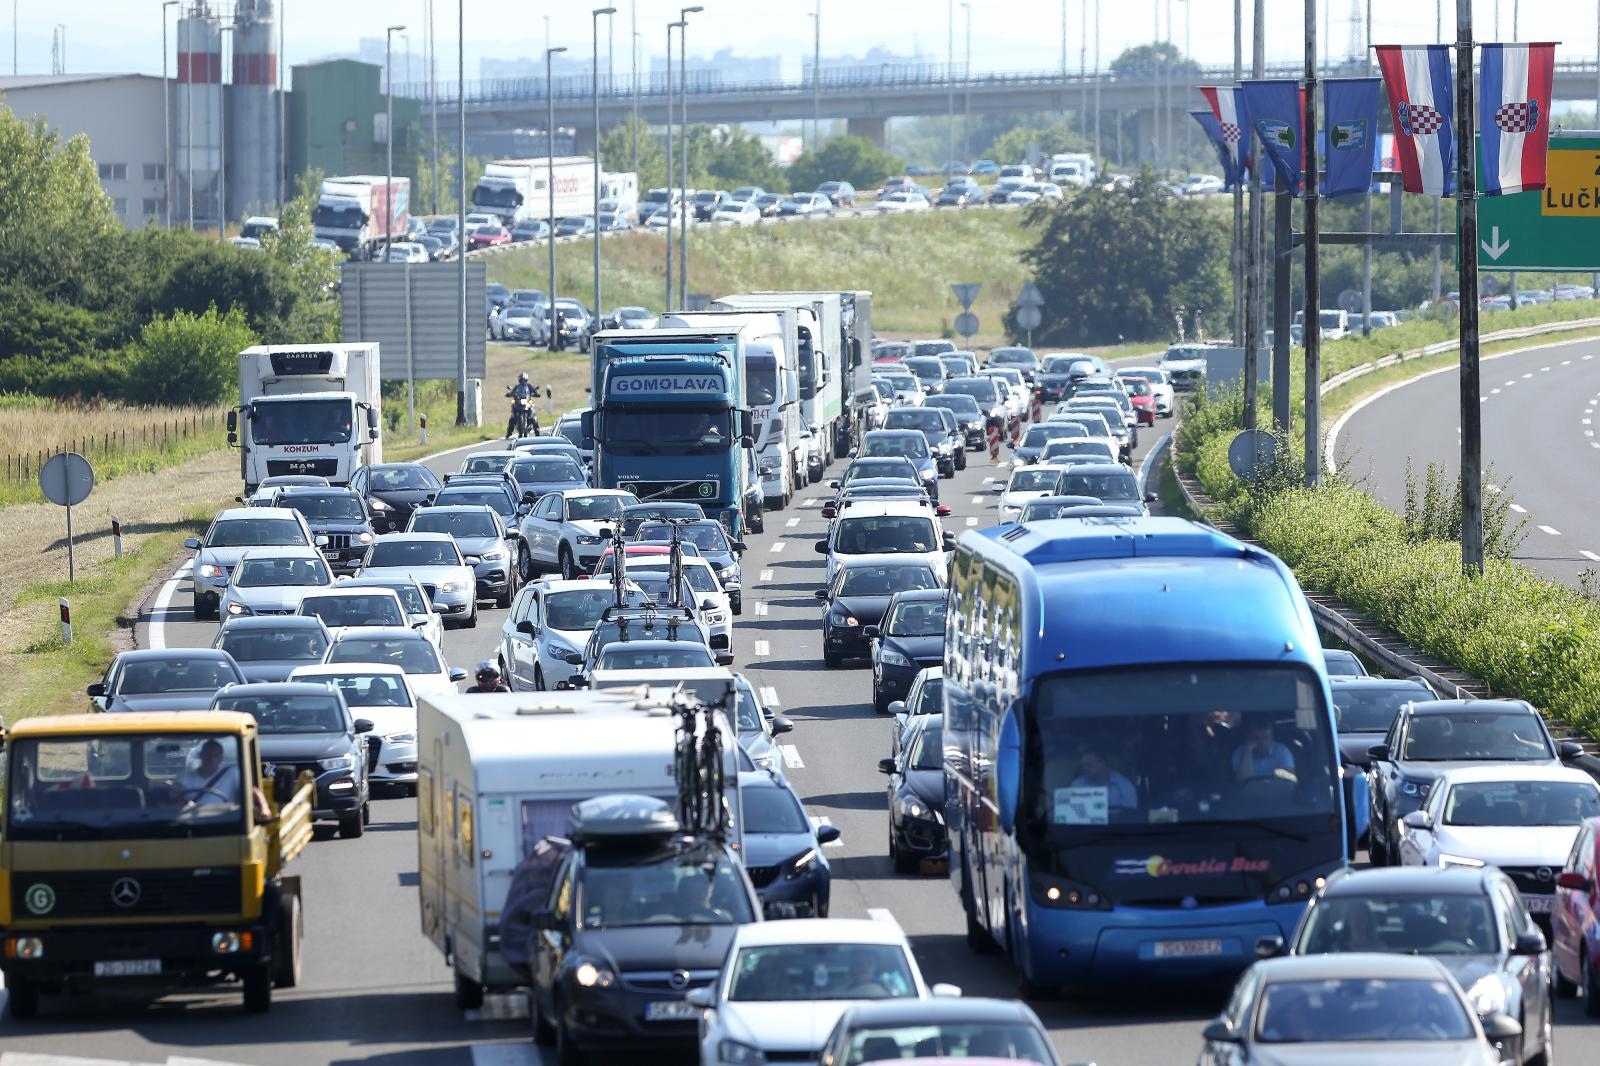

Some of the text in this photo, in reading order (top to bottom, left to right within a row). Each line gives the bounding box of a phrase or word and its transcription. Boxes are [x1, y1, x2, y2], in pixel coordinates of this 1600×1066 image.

[616, 378, 720, 391] GOMOLAVA
[1230, 856, 1271, 873] Bus
[34, 890, 47, 908] G
